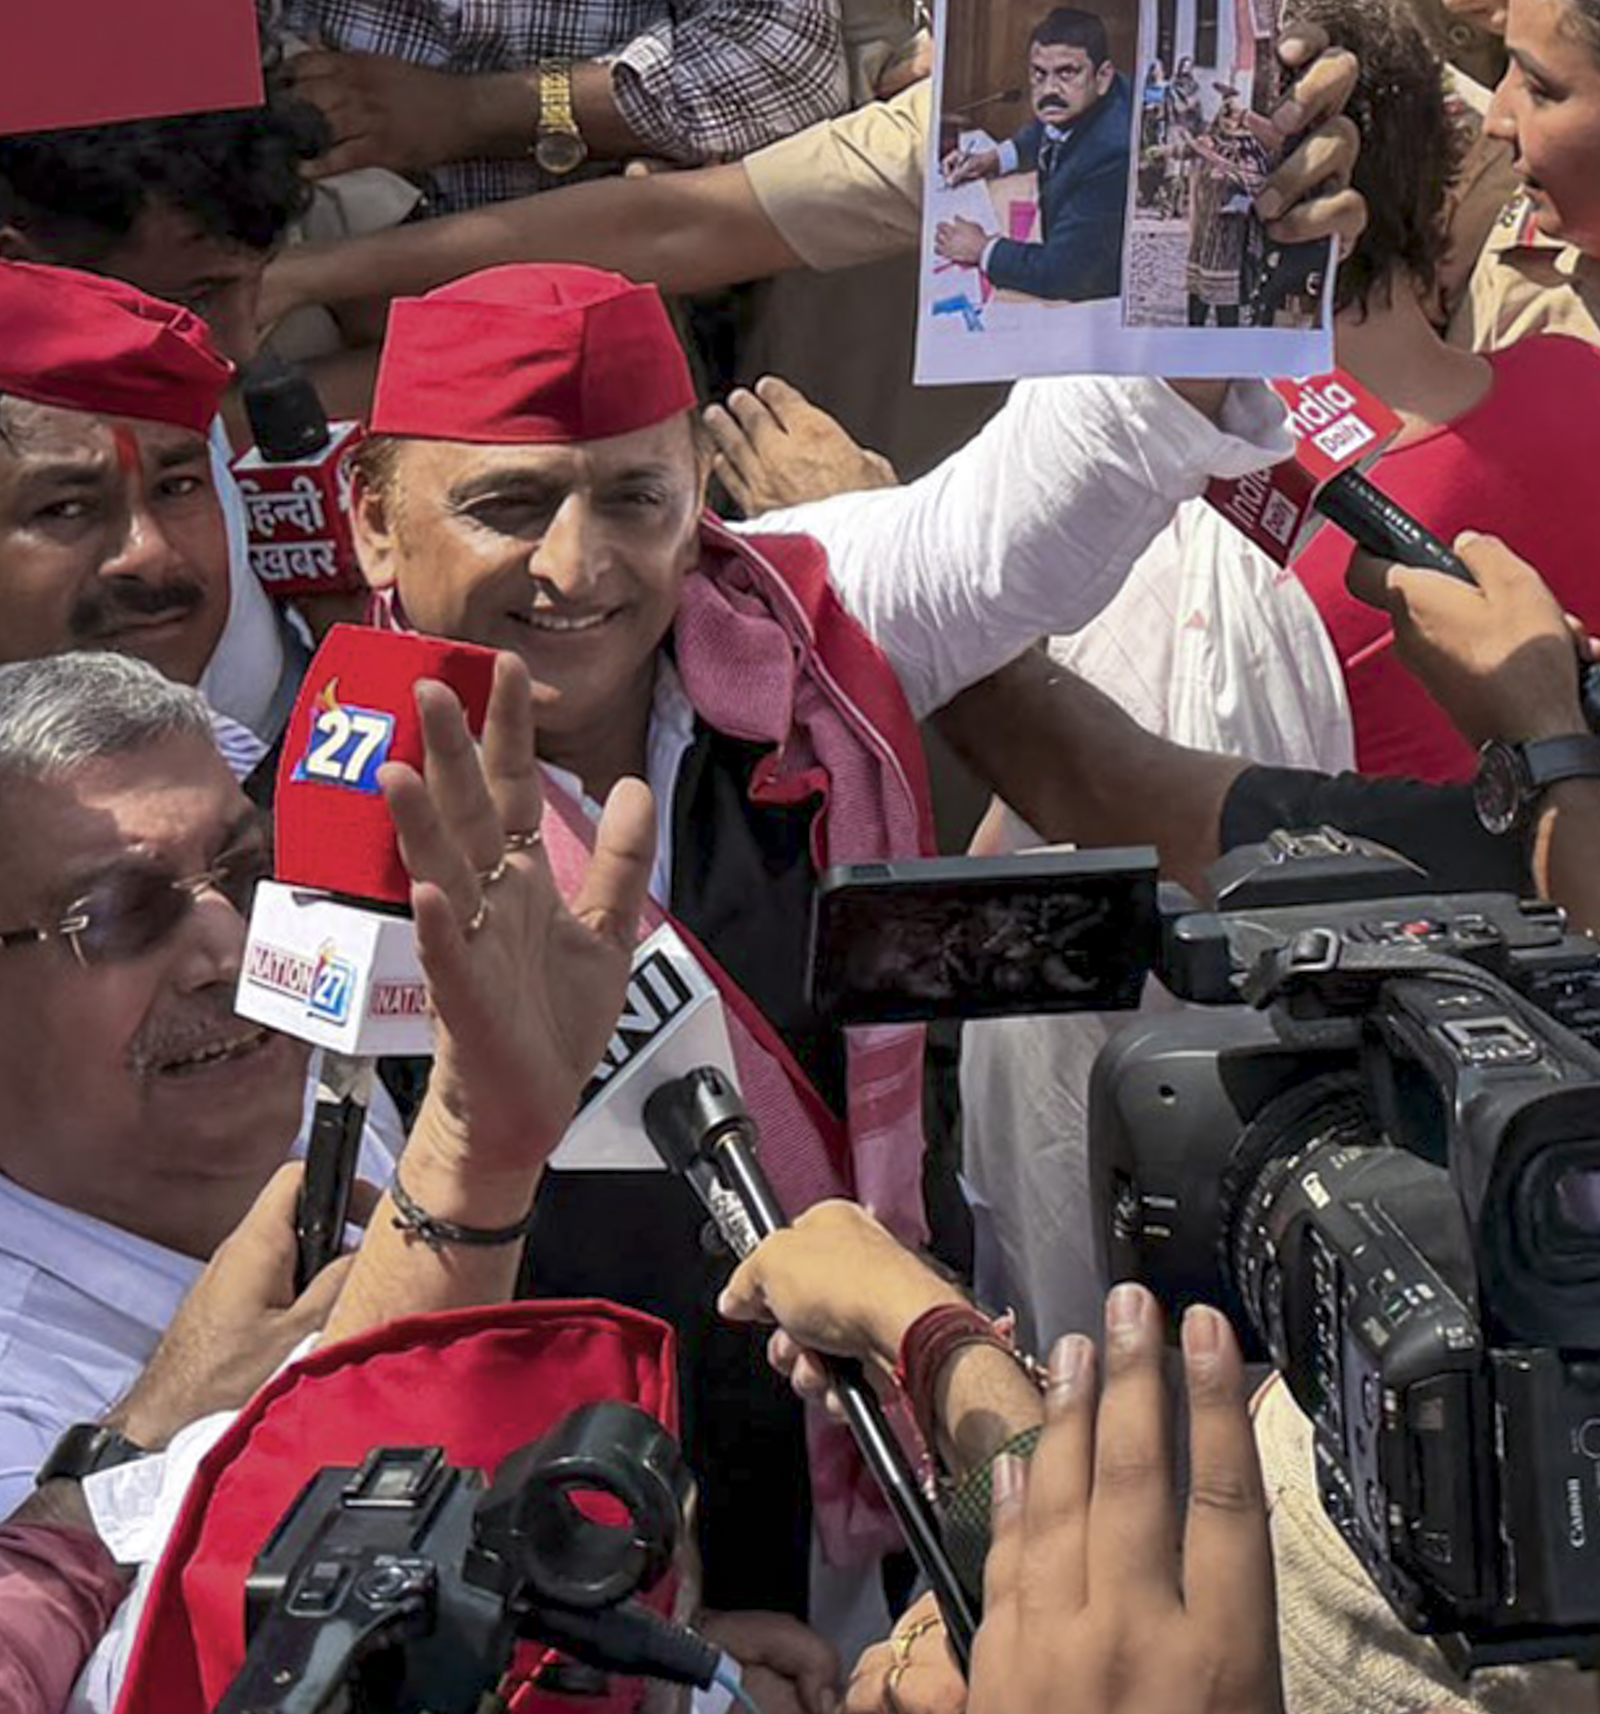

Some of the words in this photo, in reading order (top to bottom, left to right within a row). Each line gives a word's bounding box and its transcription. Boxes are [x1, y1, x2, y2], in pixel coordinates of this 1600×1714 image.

[1282, 379, 1357, 438] ndia
[250, 540, 337, 580] खबर
[306, 709, 390, 783] 27
[248, 941, 314, 998] NATION
[314, 962, 344, 1011] 27
[372, 983, 430, 1016] NATIO
[1567, 1477, 1586, 1548] Canon
